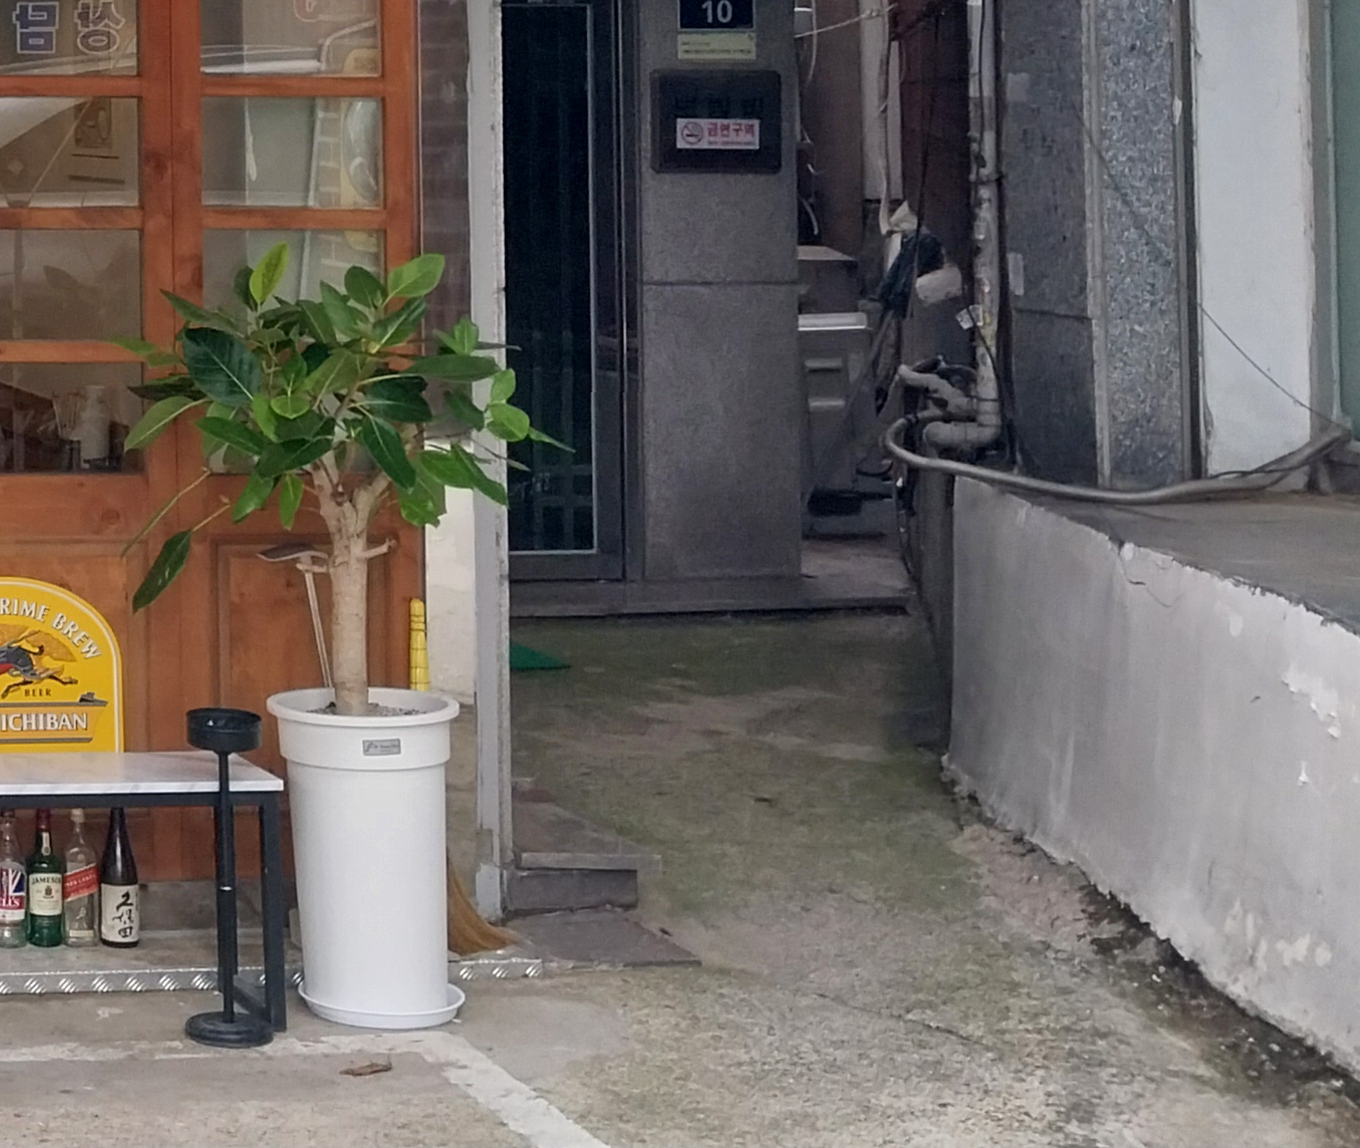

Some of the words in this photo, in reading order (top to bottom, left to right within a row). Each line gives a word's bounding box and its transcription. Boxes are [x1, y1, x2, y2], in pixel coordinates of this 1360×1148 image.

[701, 0, 733, 24] 10
[707, 121, 755, 138] 금연구역
[51, 612, 102, 660] BREW
[24, 688, 52, 697] BEER
[0, 713, 88, 732] ICHIBAN
